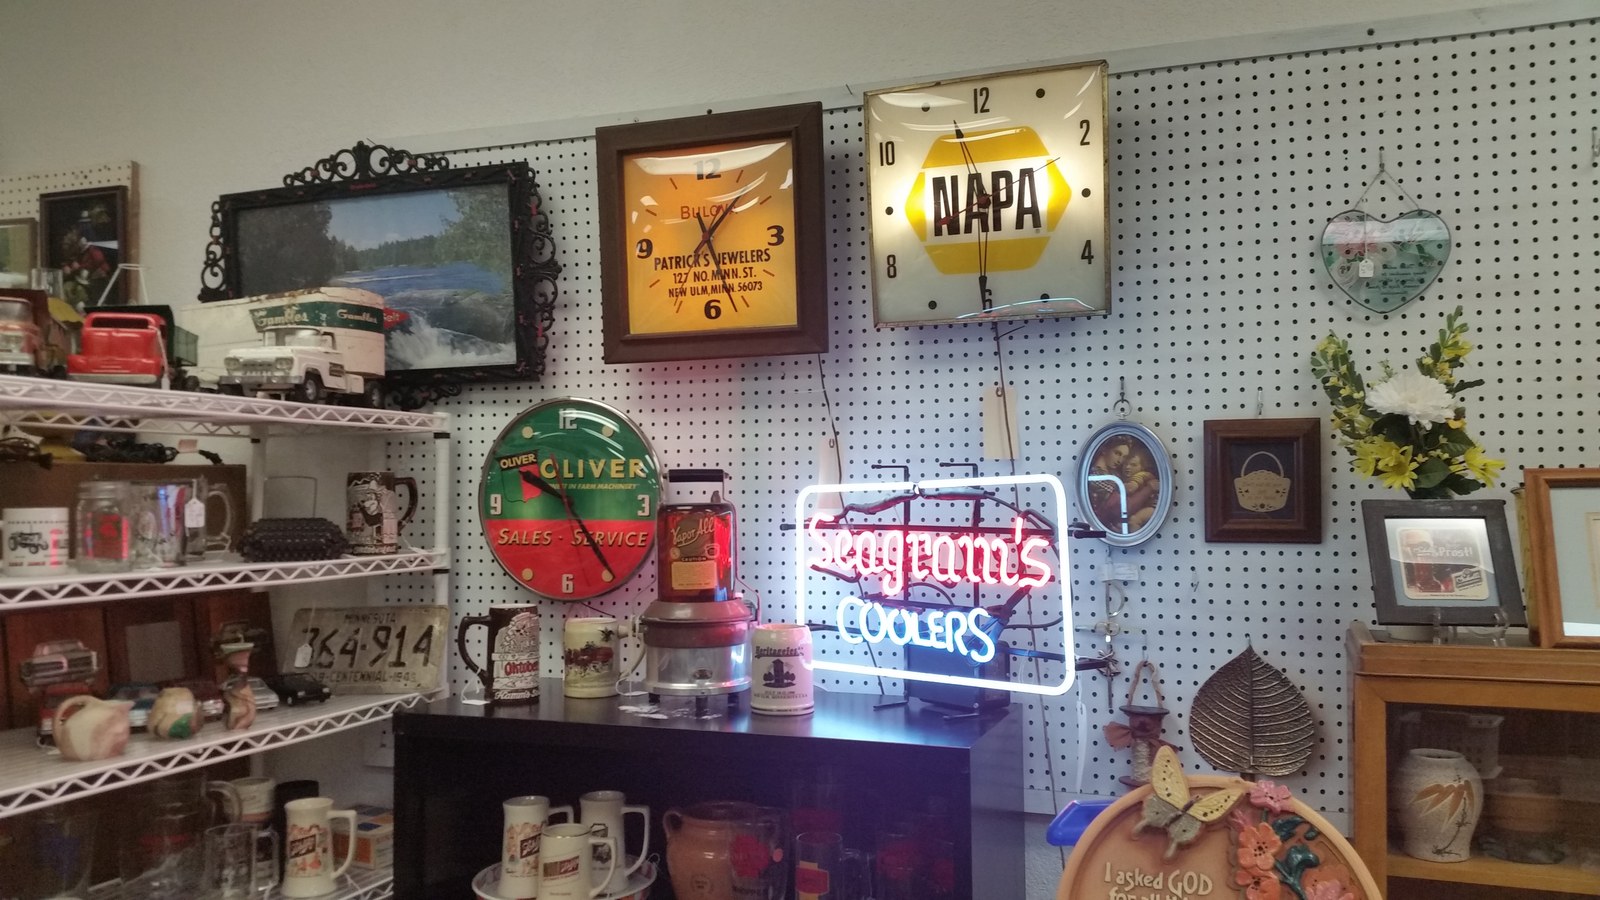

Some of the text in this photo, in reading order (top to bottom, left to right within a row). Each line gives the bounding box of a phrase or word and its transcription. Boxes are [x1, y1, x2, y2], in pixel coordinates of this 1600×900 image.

[973, 87, 990, 114] 12
[1079, 119, 1091, 146] 2
[879, 141, 896, 167] 10
[693, 158, 721, 181] 12
[932, 167, 1042, 237] NAPA
[766, 225, 785, 246] 3
[636, 238, 654, 260] 9
[654, 247, 772, 272] PATRICK'S JEWELERS
[1080, 239, 1094, 265] 4
[673, 266, 757, 285] 127 NO. MINN. ST.
[886, 254, 897, 279] 8
[668, 286, 688, 298] NEW
[737, 280, 763, 293] 56073
[704, 299, 722, 320] 6
[558, 408, 578, 430] 12
[500, 453, 537, 470] OLIVER
[540, 458, 648, 479] OLIVER
[490, 493, 502, 516] 9
[637, 494, 650, 517] 3
[498, 527, 649, 548] SALES SERVICE
[807, 511, 1052, 597] Seagram's
[561, 573, 574, 594] 6
[344, 612, 397, 625] MINNESOTA
[835, 595, 997, 664] COOLERS
[1104, 861, 1214, 899] I asked GOD
